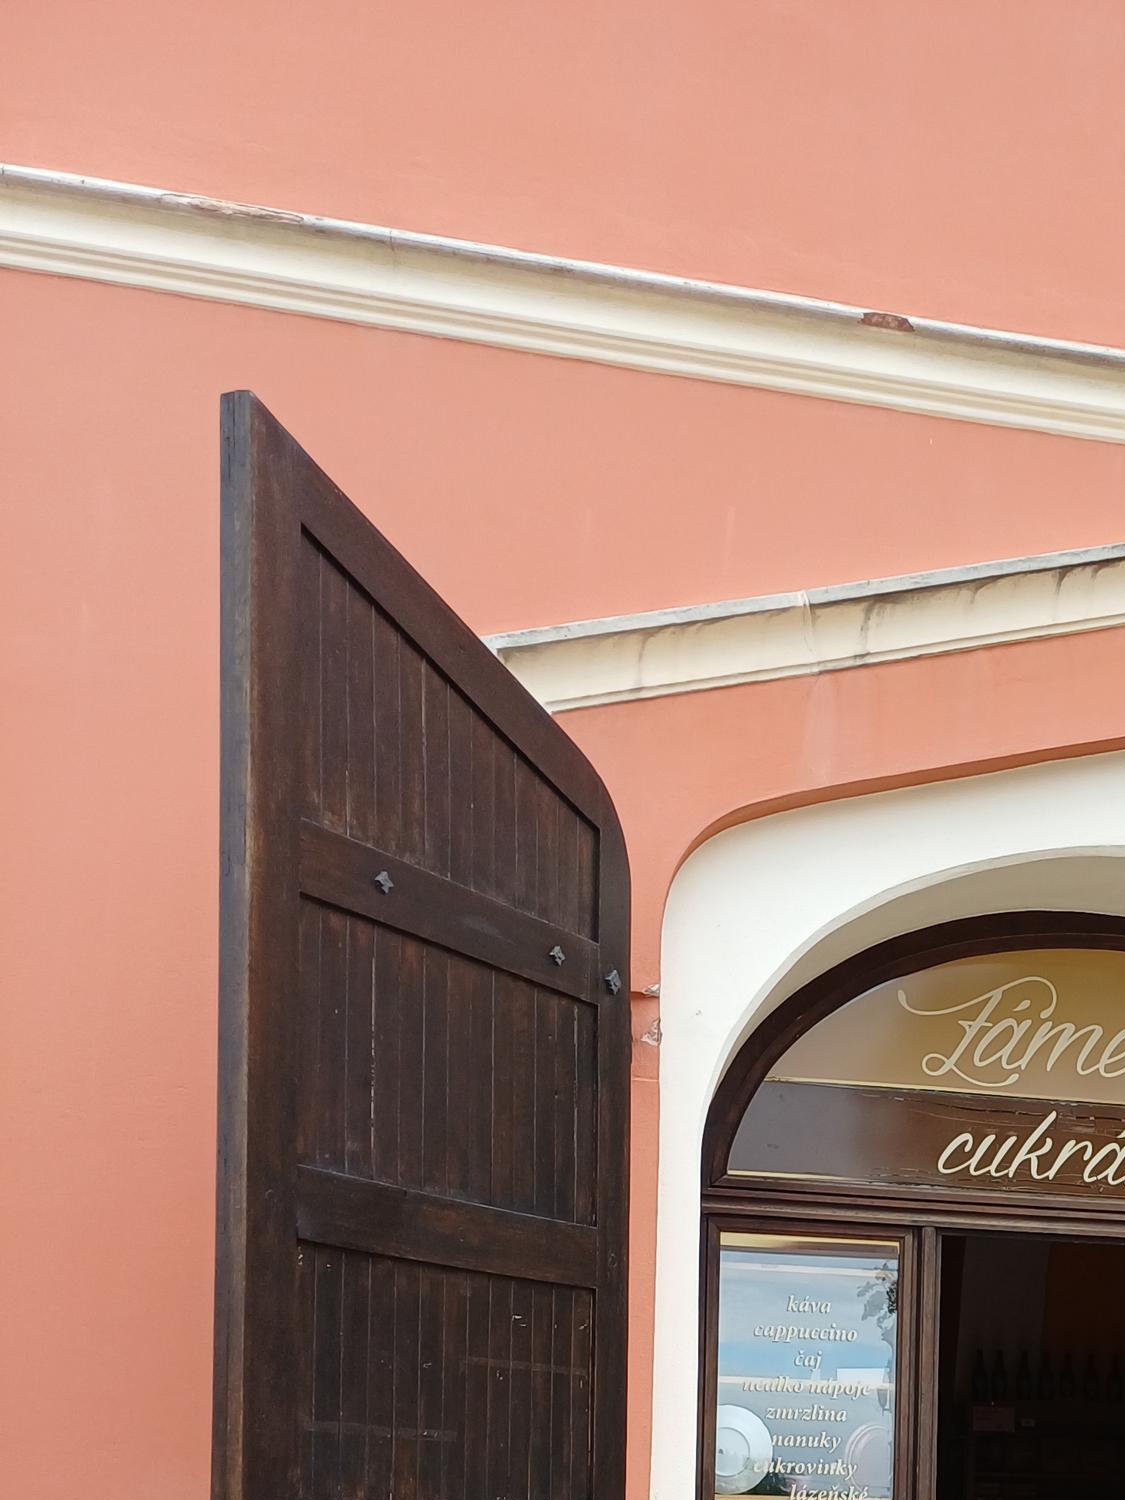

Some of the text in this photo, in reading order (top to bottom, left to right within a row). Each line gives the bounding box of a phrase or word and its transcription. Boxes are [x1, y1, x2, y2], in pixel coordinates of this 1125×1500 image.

[787, 1294, 832, 1314] káva
[753, 1322, 859, 1345] cappuccino
[794, 1349, 823, 1371] čaj
[742, 1375, 871, 1400] nealko nápoje
[765, 1404, 848, 1423] zmrzlina
[771, 1431, 841, 1454] nanuky
[753, 1456, 858, 1480] cukrovinky
